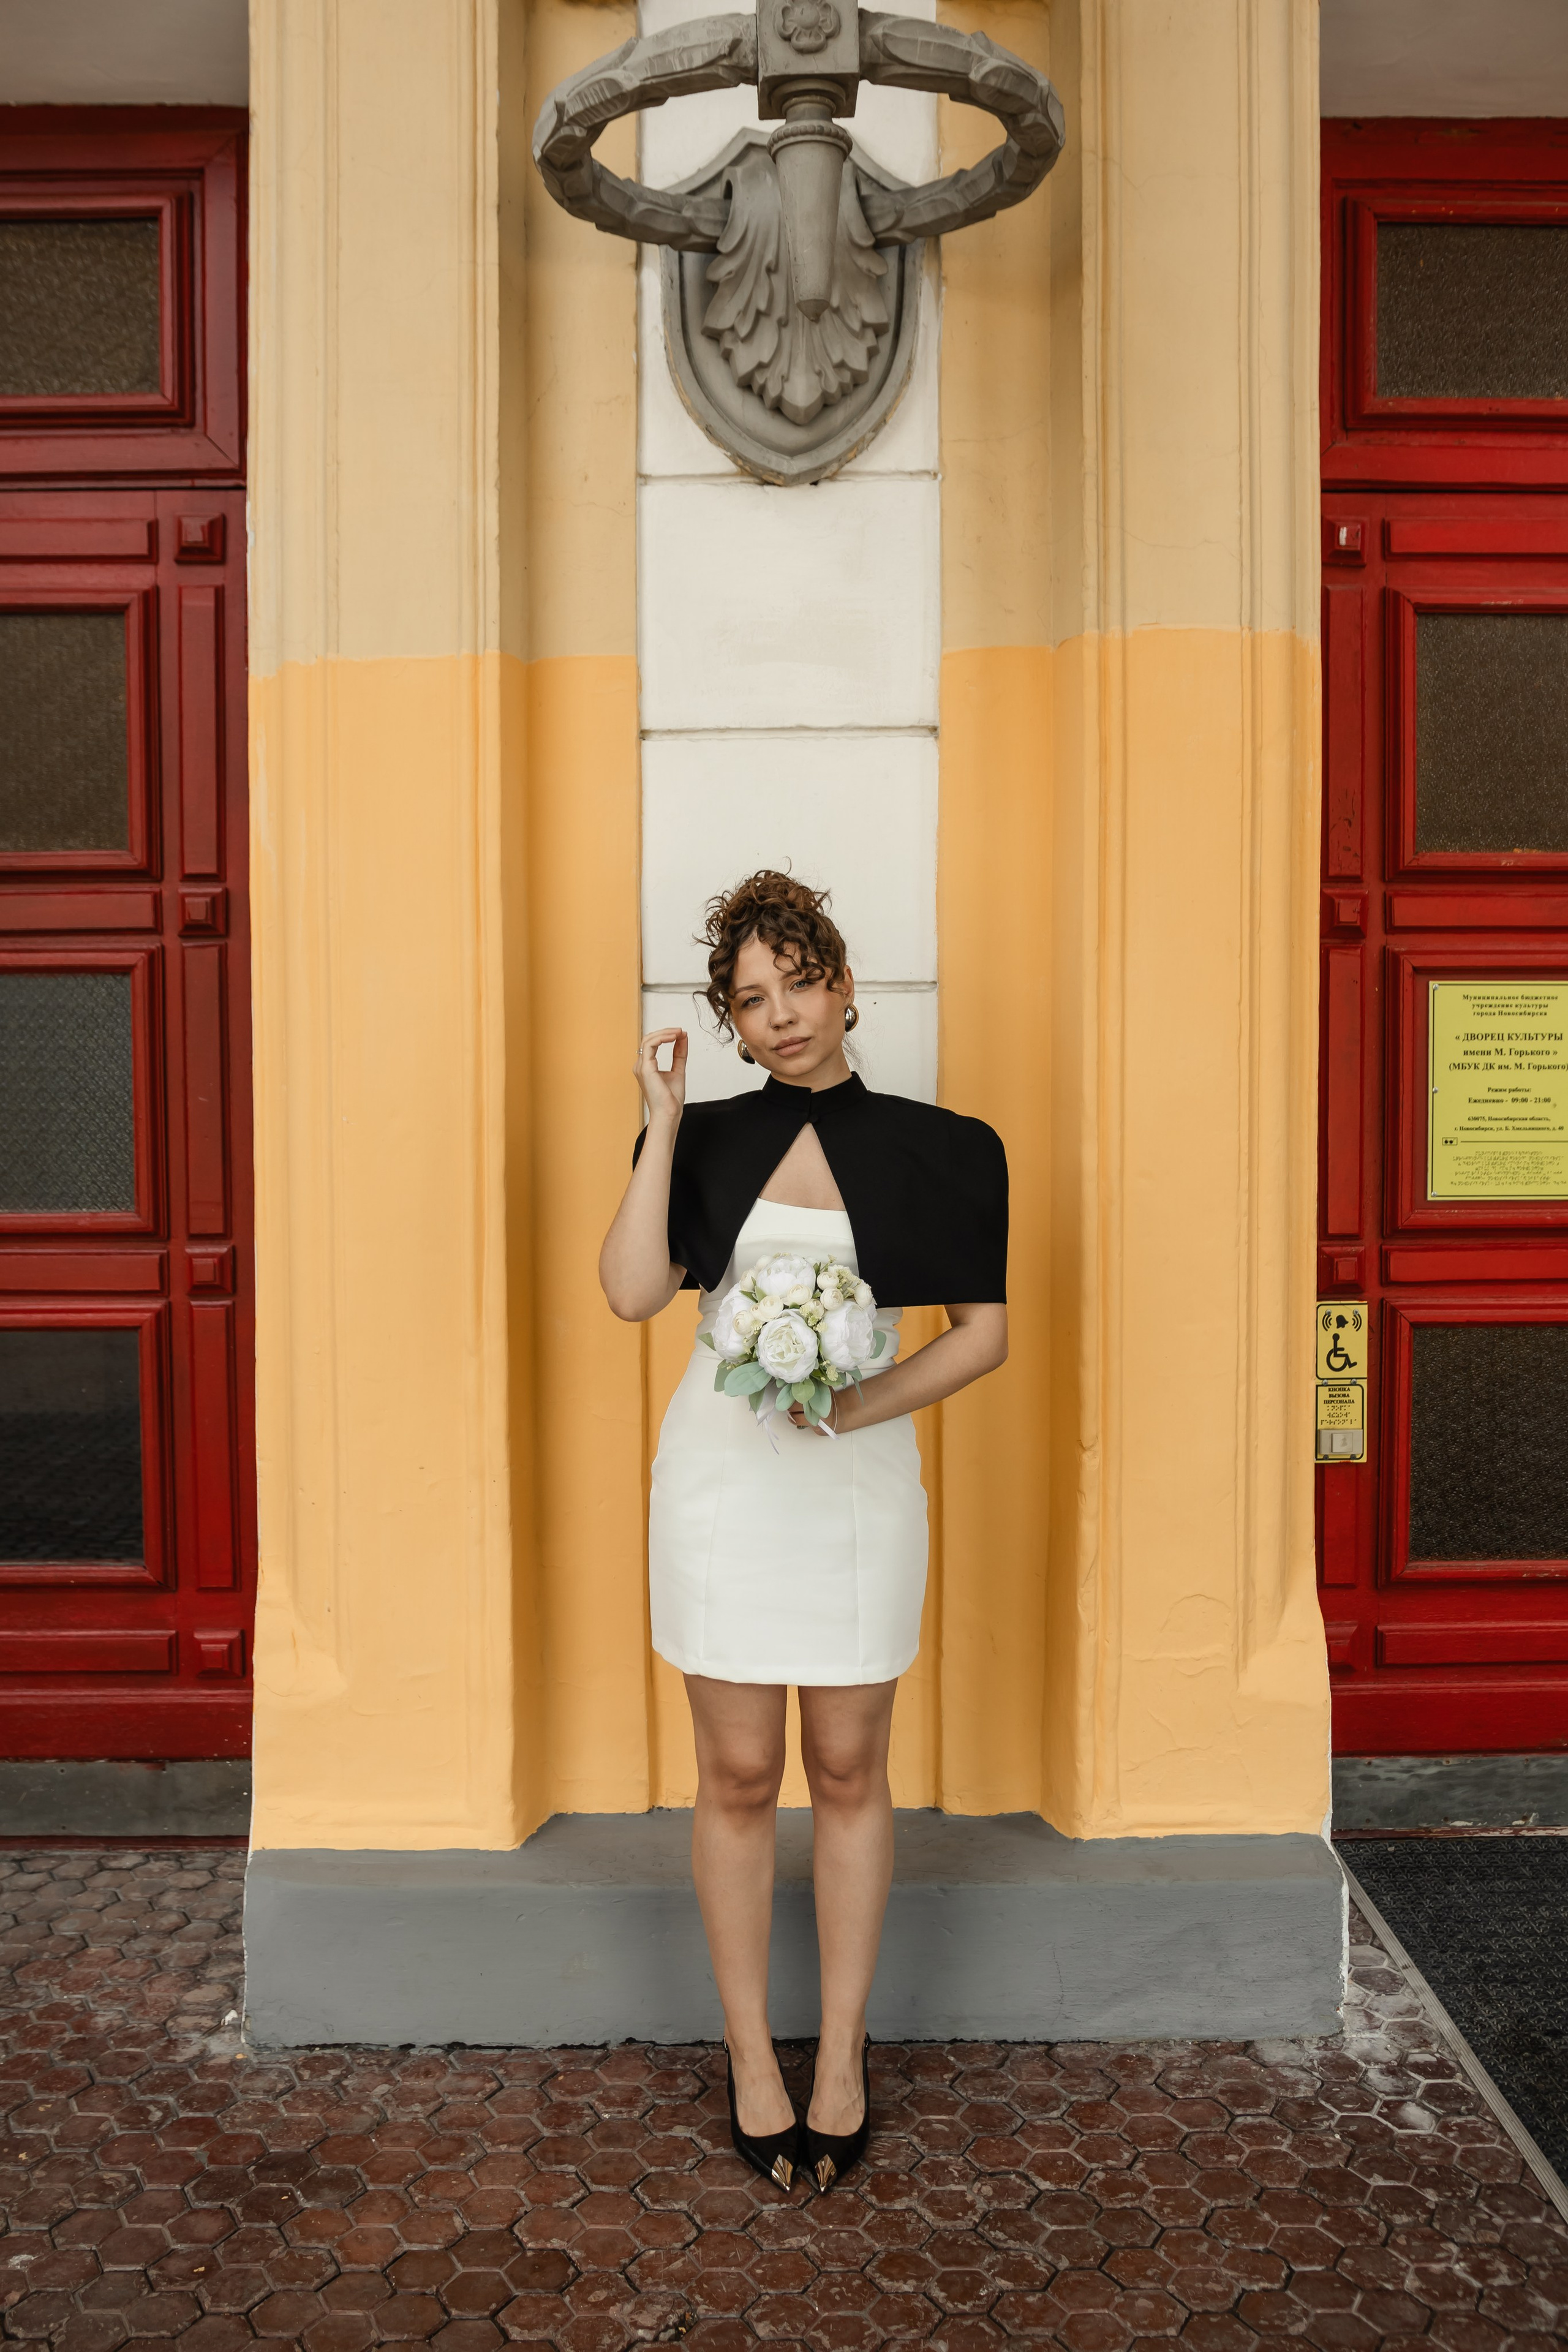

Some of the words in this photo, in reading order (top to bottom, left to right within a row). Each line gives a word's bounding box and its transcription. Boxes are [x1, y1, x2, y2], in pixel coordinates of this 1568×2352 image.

[1462, 1033, 1504, 1042] ДВОРЕЦ
[1507, 1033, 1563, 1041] КУЛЬТУРЫ
[1509, 1048, 1550, 1058] Горького
[1449, 1063, 1480, 1071] (МБУК
[1482, 1063, 1496, 1071] ДК
[1528, 1063, 1568, 1072] Горького)
